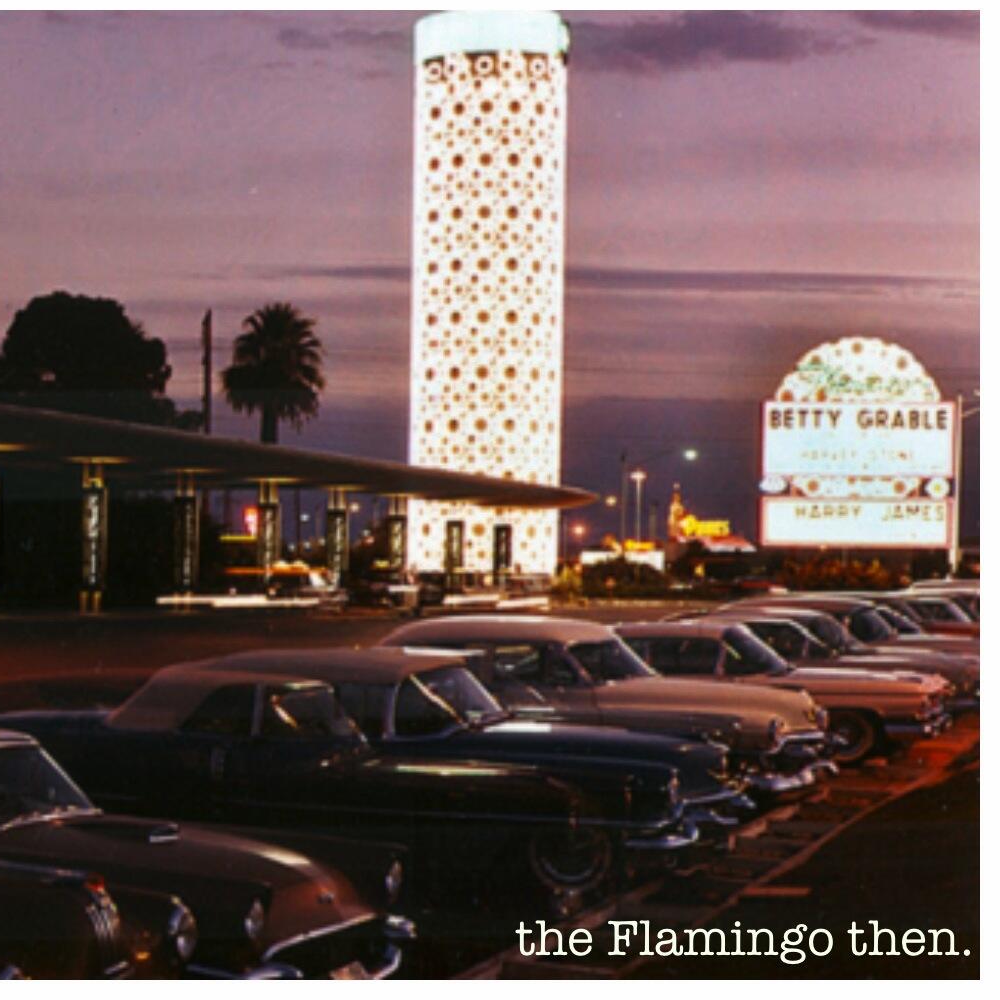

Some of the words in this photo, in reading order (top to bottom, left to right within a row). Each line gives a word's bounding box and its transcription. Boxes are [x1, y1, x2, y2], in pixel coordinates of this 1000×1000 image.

[768, 408, 842, 430] BETTY
[856, 408, 948, 430] GRABLE
[881, 504, 945, 521] JAMES
